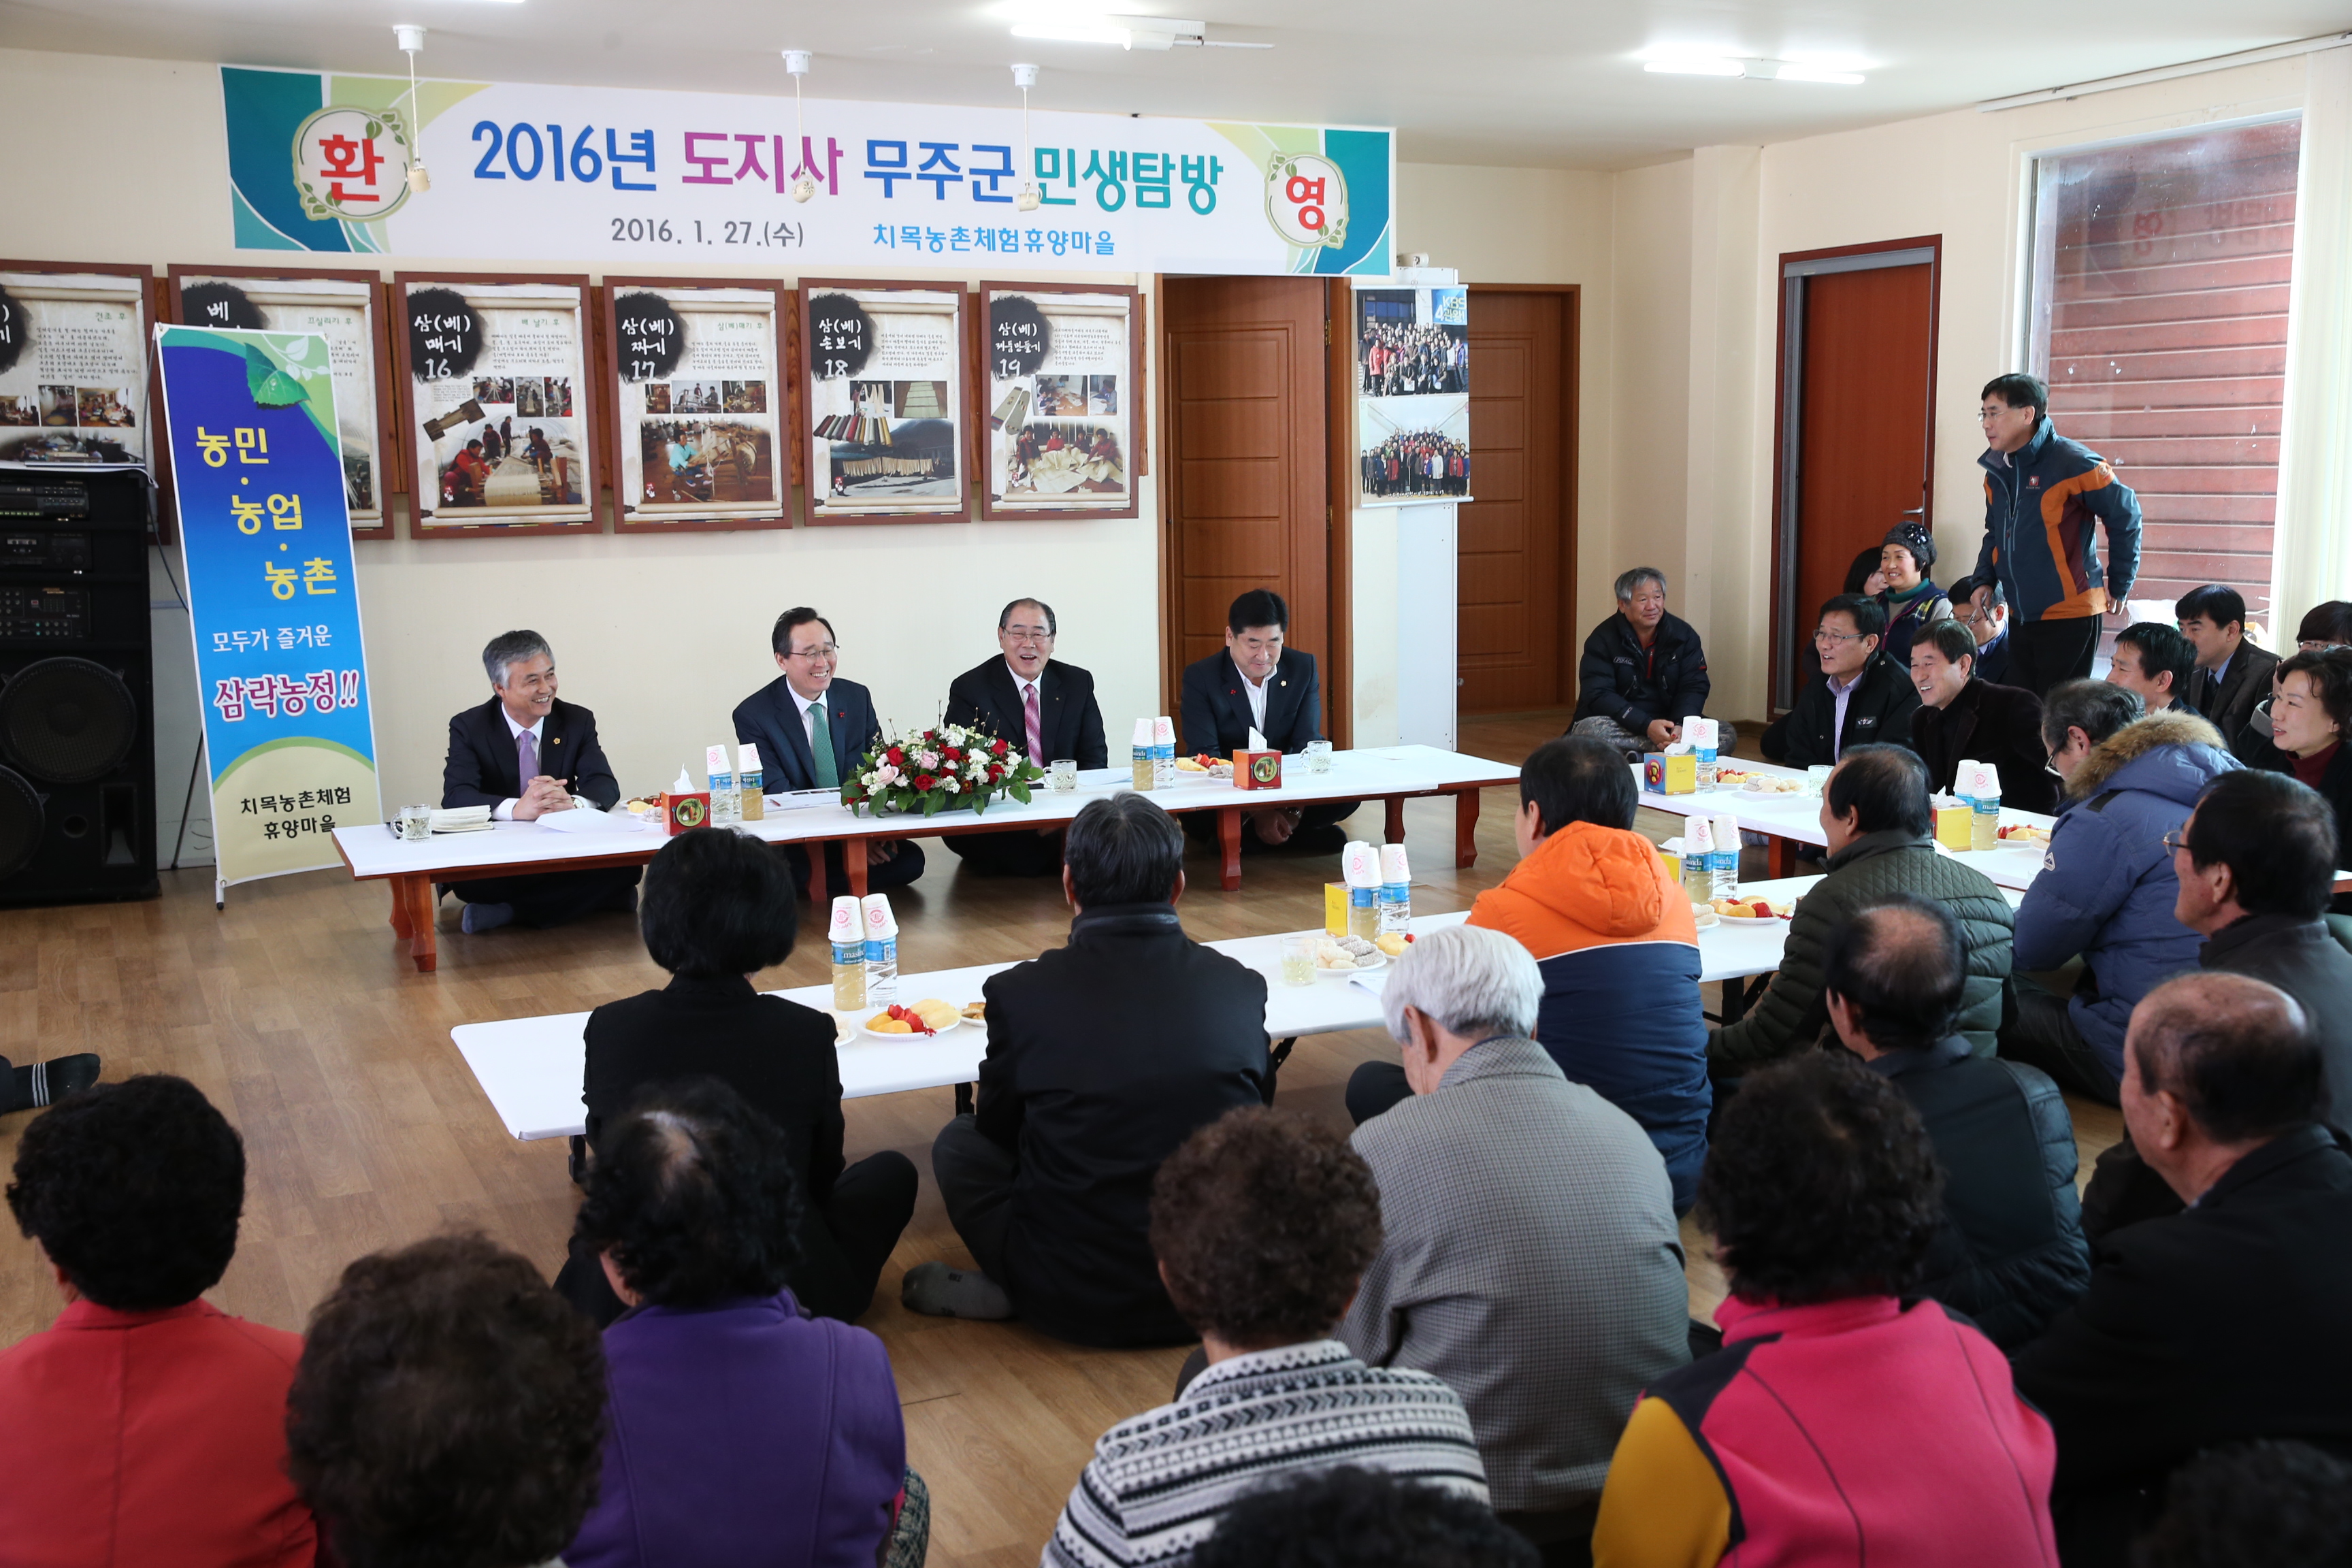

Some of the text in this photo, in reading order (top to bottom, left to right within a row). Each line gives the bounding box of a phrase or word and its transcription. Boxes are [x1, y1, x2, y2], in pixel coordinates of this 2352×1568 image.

[318, 133, 385, 203] 환
[472, 120, 1224, 216] 2016년 도지사 무주군 민생탐방
[1286, 174, 1326, 231] 영
[611, 217, 682, 244] 2016.
[724, 220, 804, 248] 27.(수)
[206, 301, 229, 322] 베
[1442, 295, 1467, 310] KBS
[414, 314, 471, 333] 삼(베)
[621, 317, 674, 336] 삼(베)
[819, 318, 862, 333] 삼(베)
[998, 322, 1037, 337] 삼(베)
[425, 335, 463, 353] 매기
[631, 338, 666, 356] 짜기
[819, 335, 862, 351] 손보기
[425, 358, 452, 379] 16
[631, 360, 656, 380] 17
[824, 359, 849, 378] 18
[999, 358, 1021, 377] 19
[196, 426, 270, 468] 농민
[230, 493, 303, 535] 농업
[265, 557, 337, 600] 농촌
[212, 624, 333, 653] 모두가 즐거운
[213, 669, 360, 723] 삼락농정!!
[241, 787, 351, 815] 치목농촌체험
[263, 815, 336, 840] 휴양마을
